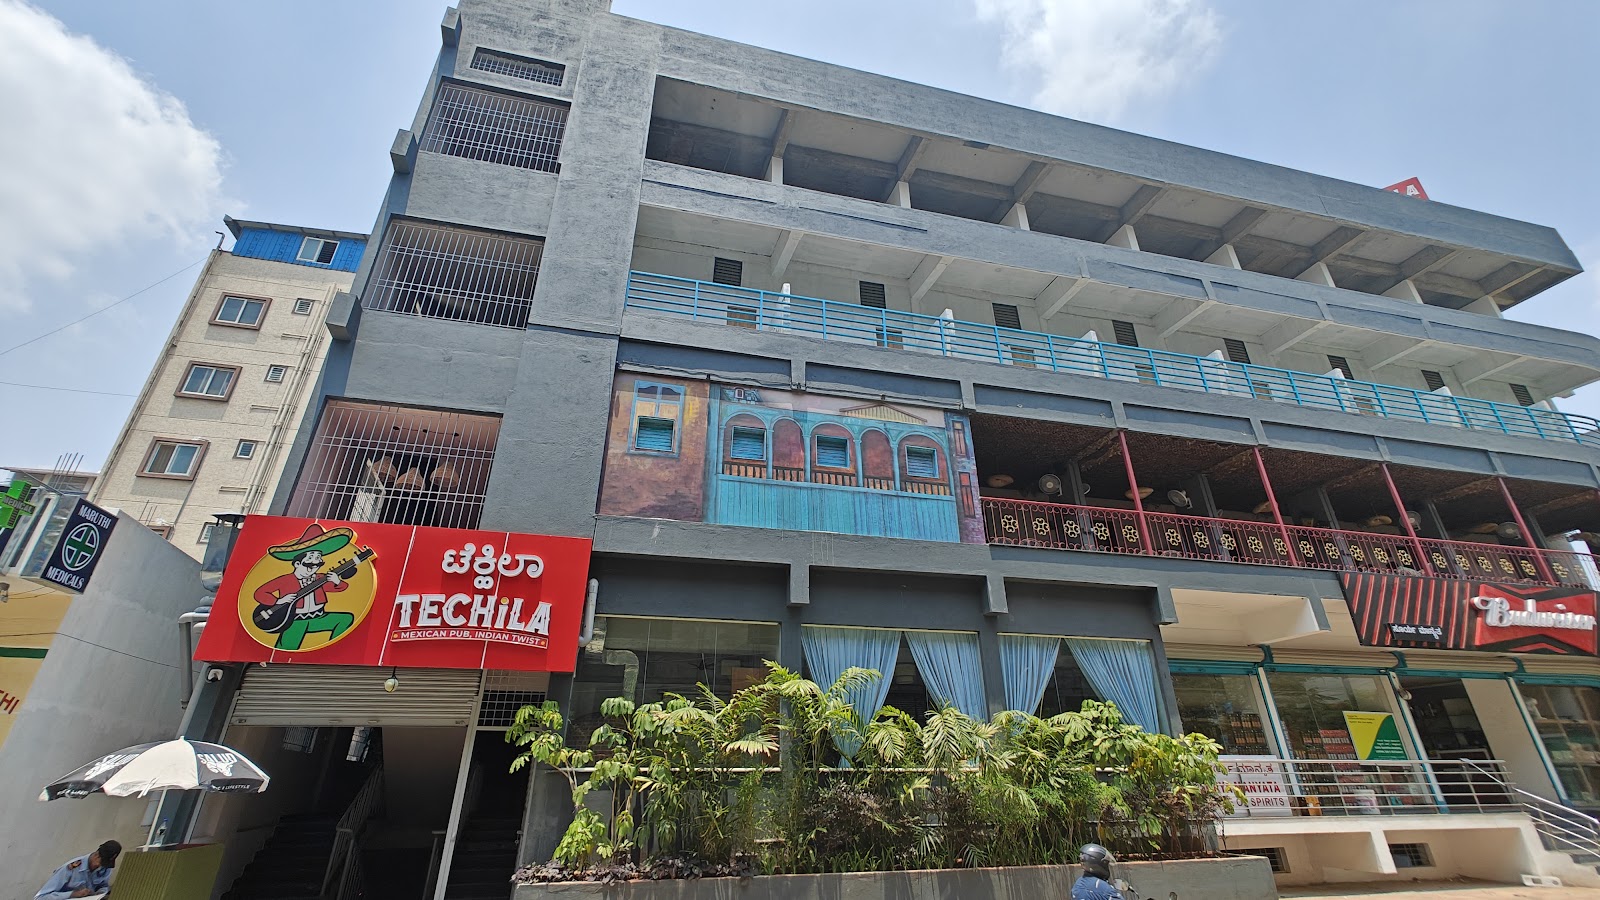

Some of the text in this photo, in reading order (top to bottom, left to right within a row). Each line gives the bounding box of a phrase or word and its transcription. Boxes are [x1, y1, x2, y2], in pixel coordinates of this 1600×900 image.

[78, 505, 112, 529] MARUTHI
[46, 566, 84, 589] MEDICALS
[400, 630, 541, 645] MEXICAN PUB, INDIAN TWIST
[0, 689, 20, 715] HI
[197, 752, 237, 764] SALUD
[1251, 797, 1285, 807] SPIRITS
